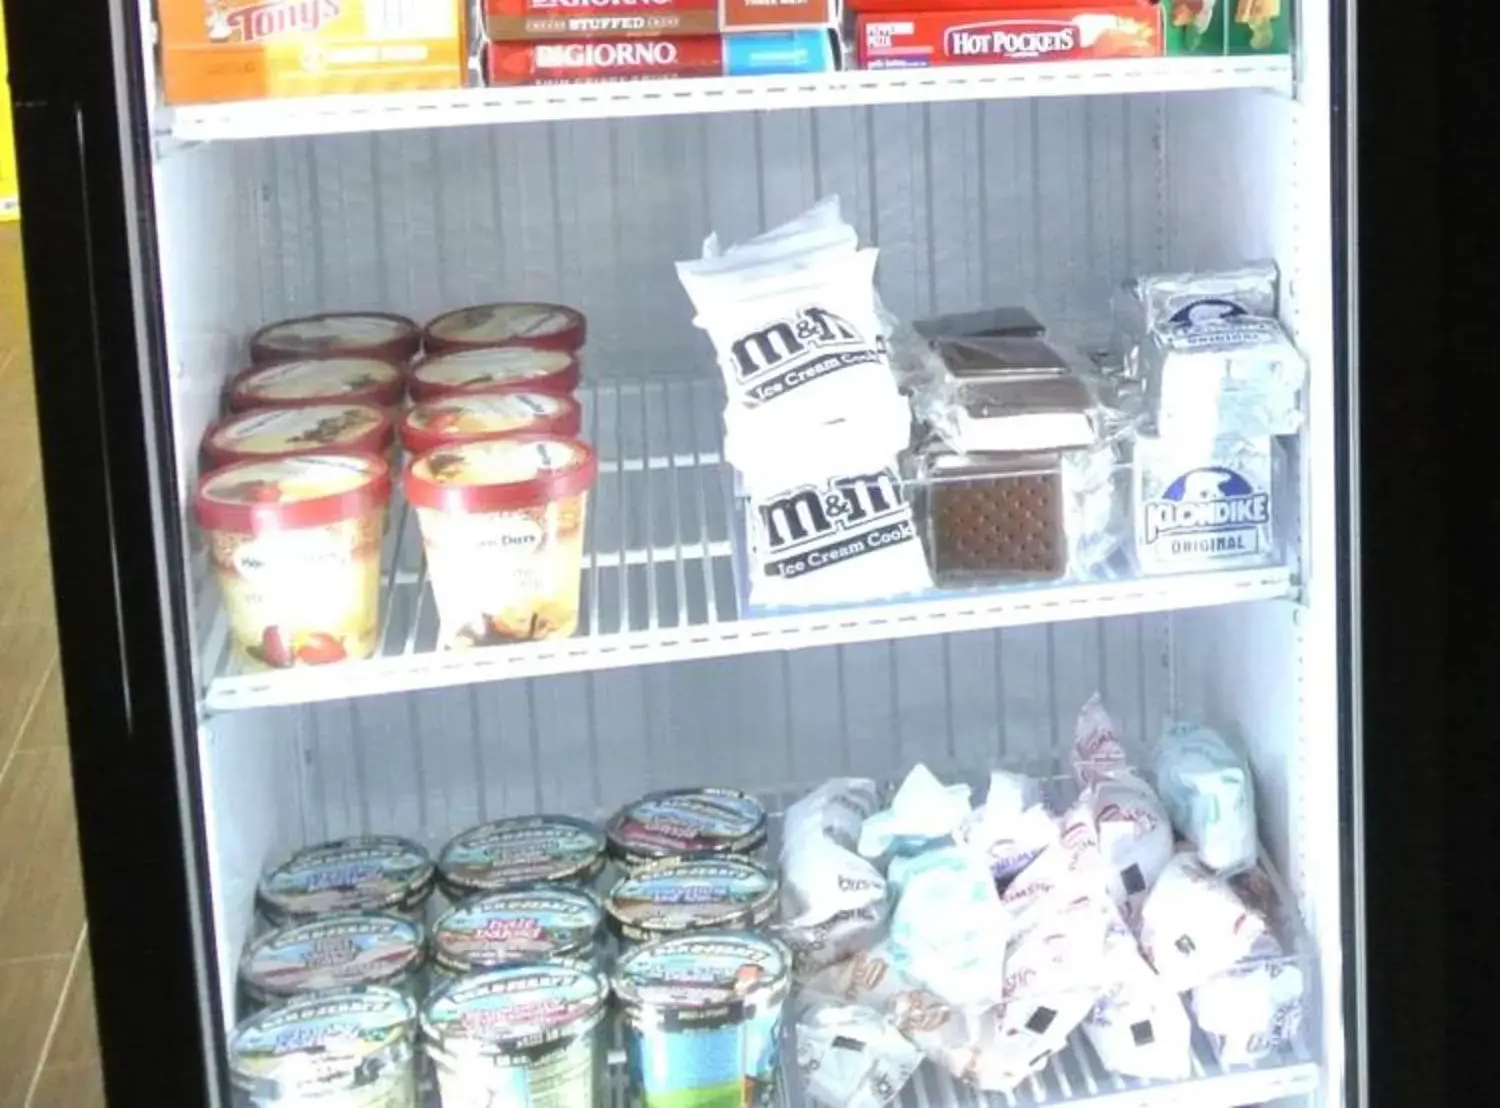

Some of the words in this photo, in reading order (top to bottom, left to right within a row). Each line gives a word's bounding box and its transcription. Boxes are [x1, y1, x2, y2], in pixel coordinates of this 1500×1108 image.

[568, 16, 646, 32] STUFFED
[535, 42, 677, 69] DIGIORNO
[953, 31, 992, 55] HOT
[993, 30, 1075, 54] POCKETS
[1146, 492, 1269, 545] KLONDIKE
[1171, 535, 1246, 553] ORIGINAL
[778, 560, 805, 579] Ice
[807, 538, 864, 569] Cream
